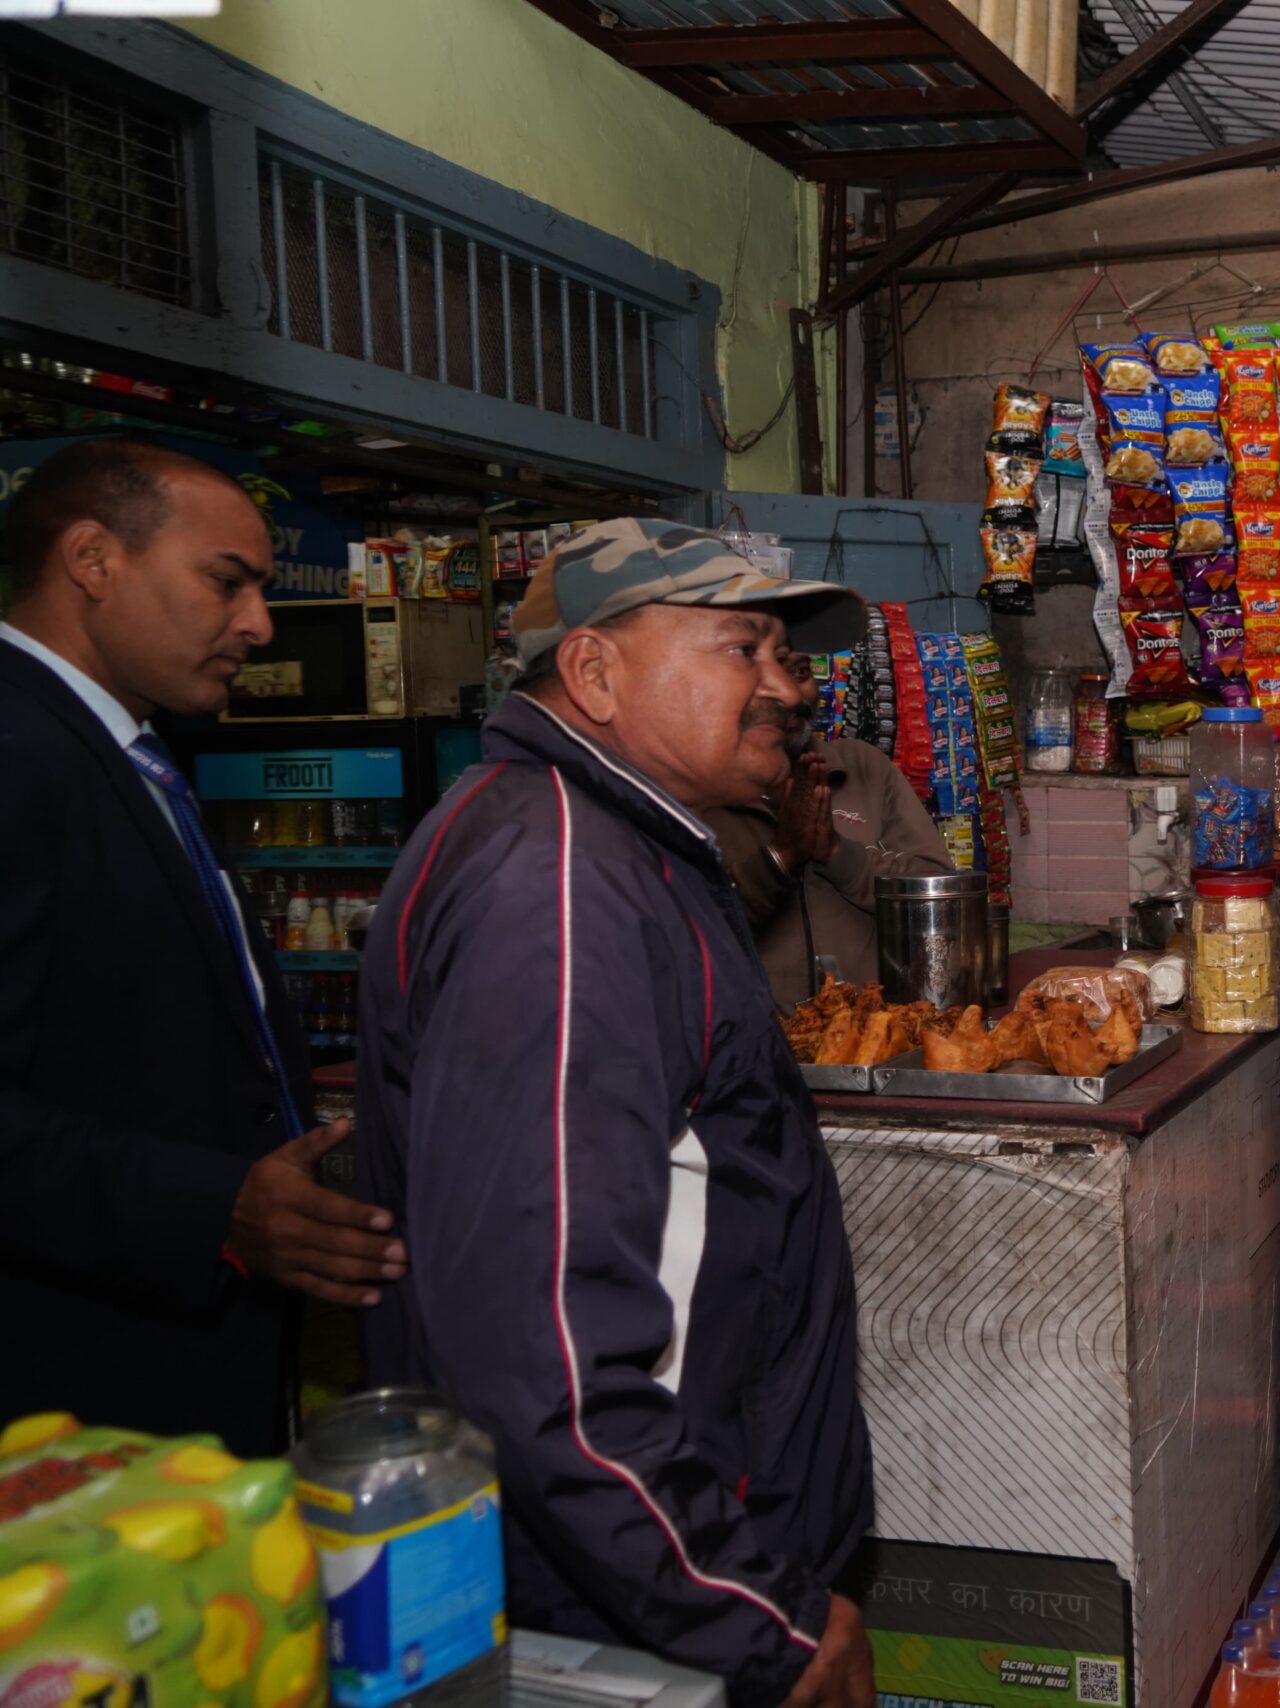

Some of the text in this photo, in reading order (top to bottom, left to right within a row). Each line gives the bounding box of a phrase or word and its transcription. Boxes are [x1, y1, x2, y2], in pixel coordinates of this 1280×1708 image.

[1184, 389, 1214, 401] Uncle
[1130, 408, 1159, 419] Uncle
[1192, 480, 1221, 489] Uncle
[455, 560, 477, 573] 444
[1206, 627, 1245, 640] Dorito
[263, 762, 334, 789] FROOTI
[949, 1582, 991, 1611] का
[1006, 1588, 1093, 1623] कारण
[1000, 1660, 1070, 1677] SCAN HERE
[1000, 1672, 1071, 1689] TO WIN BIG!
